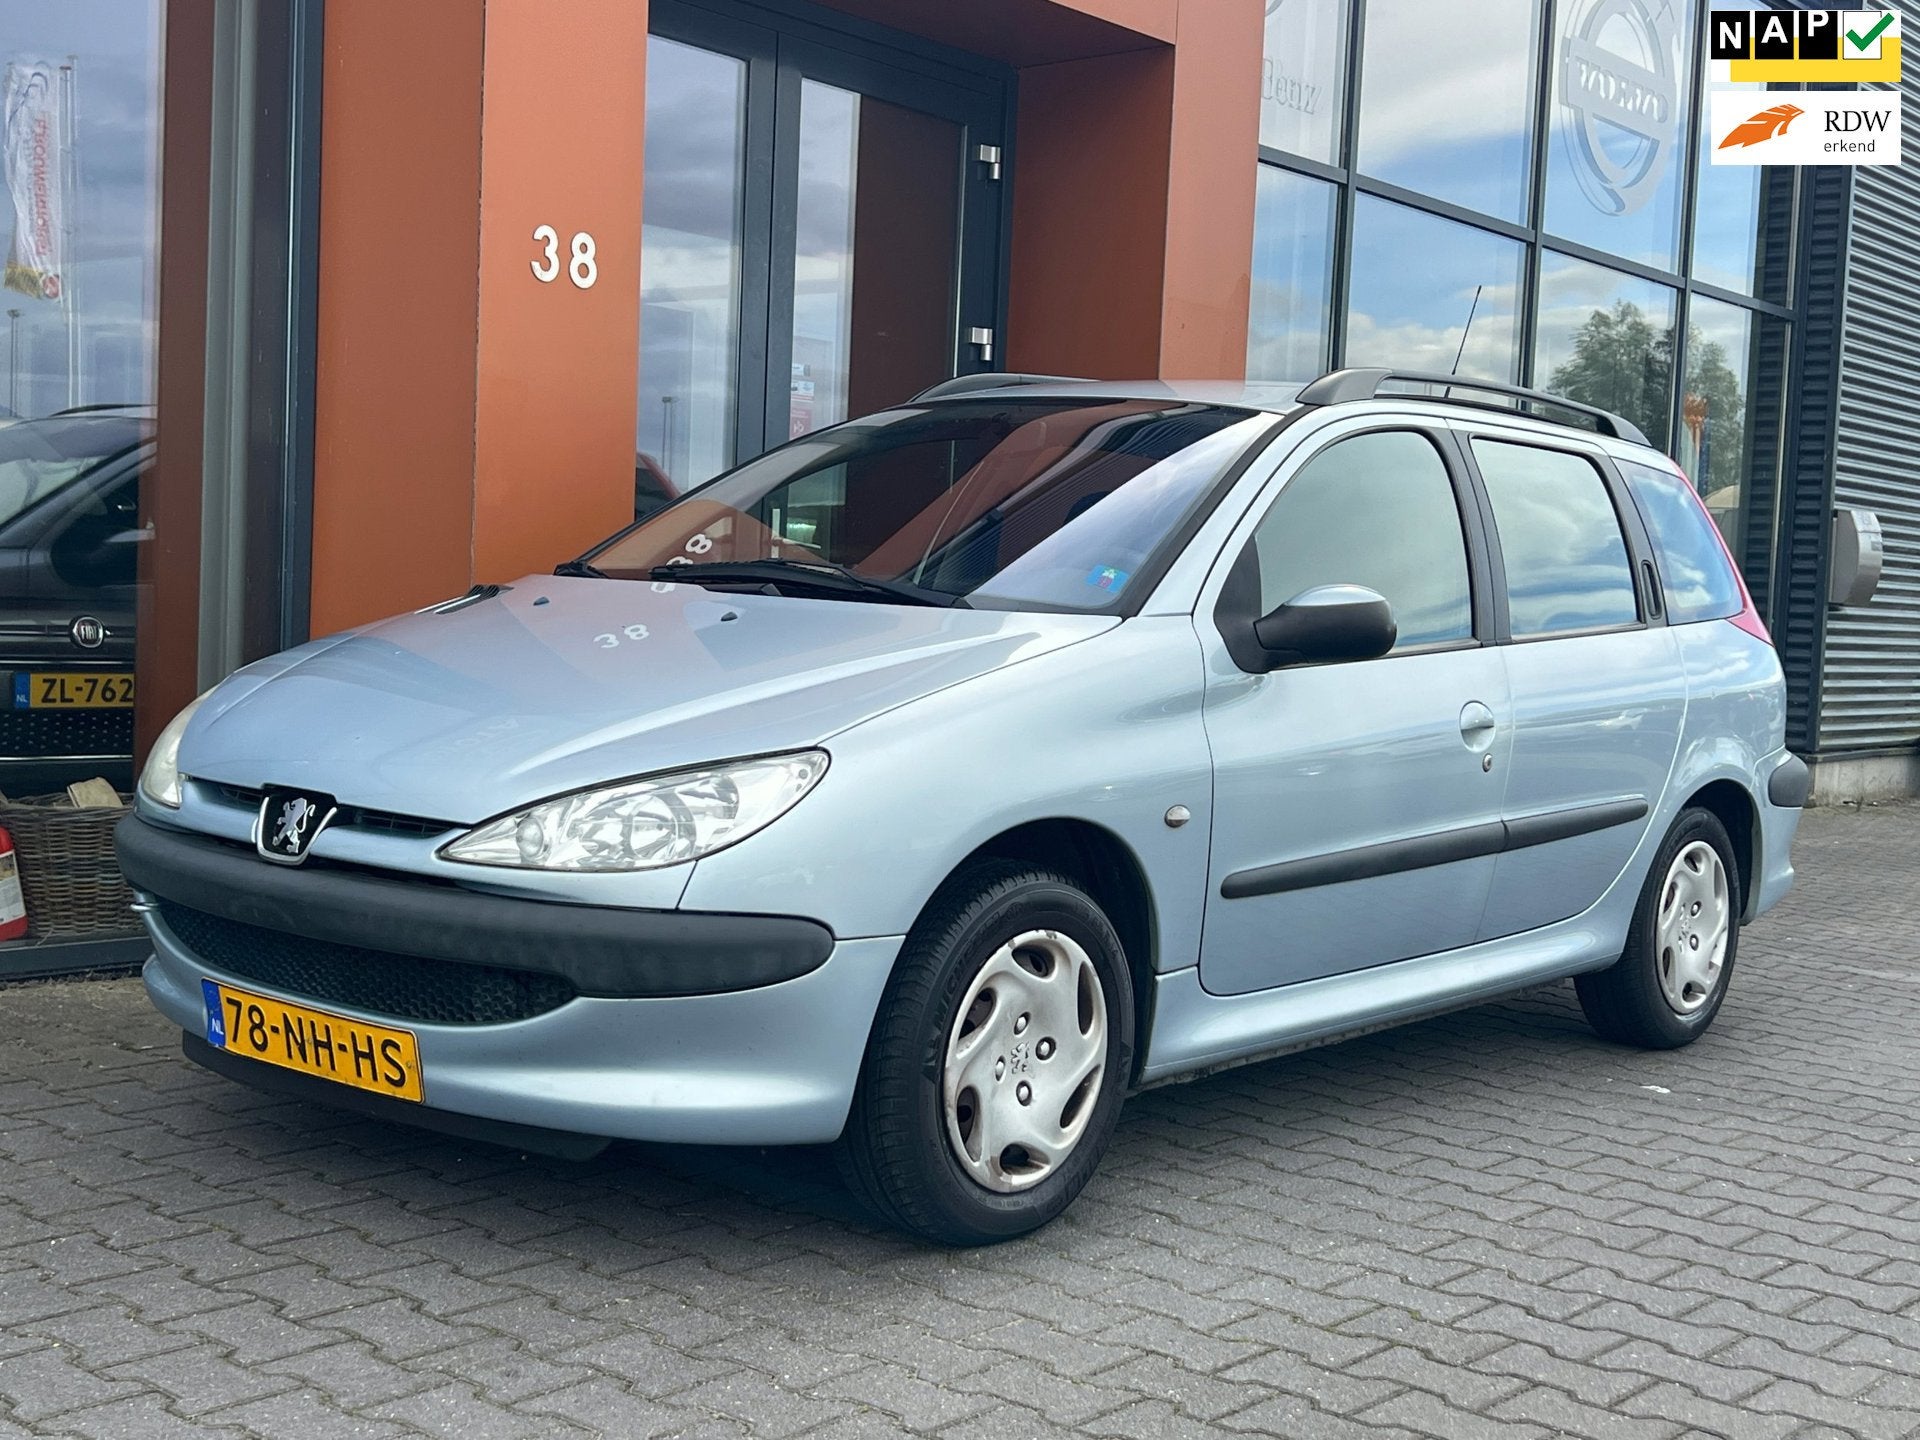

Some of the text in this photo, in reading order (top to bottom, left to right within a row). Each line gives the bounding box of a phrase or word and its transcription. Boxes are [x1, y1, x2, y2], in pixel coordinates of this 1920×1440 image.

[530, 224, 598, 290] 38
[80, 625, 97, 640] FIAT
[16, 678, 134, 703] NL ZL-762
[211, 997, 407, 1088] NL 78-NH-HS
